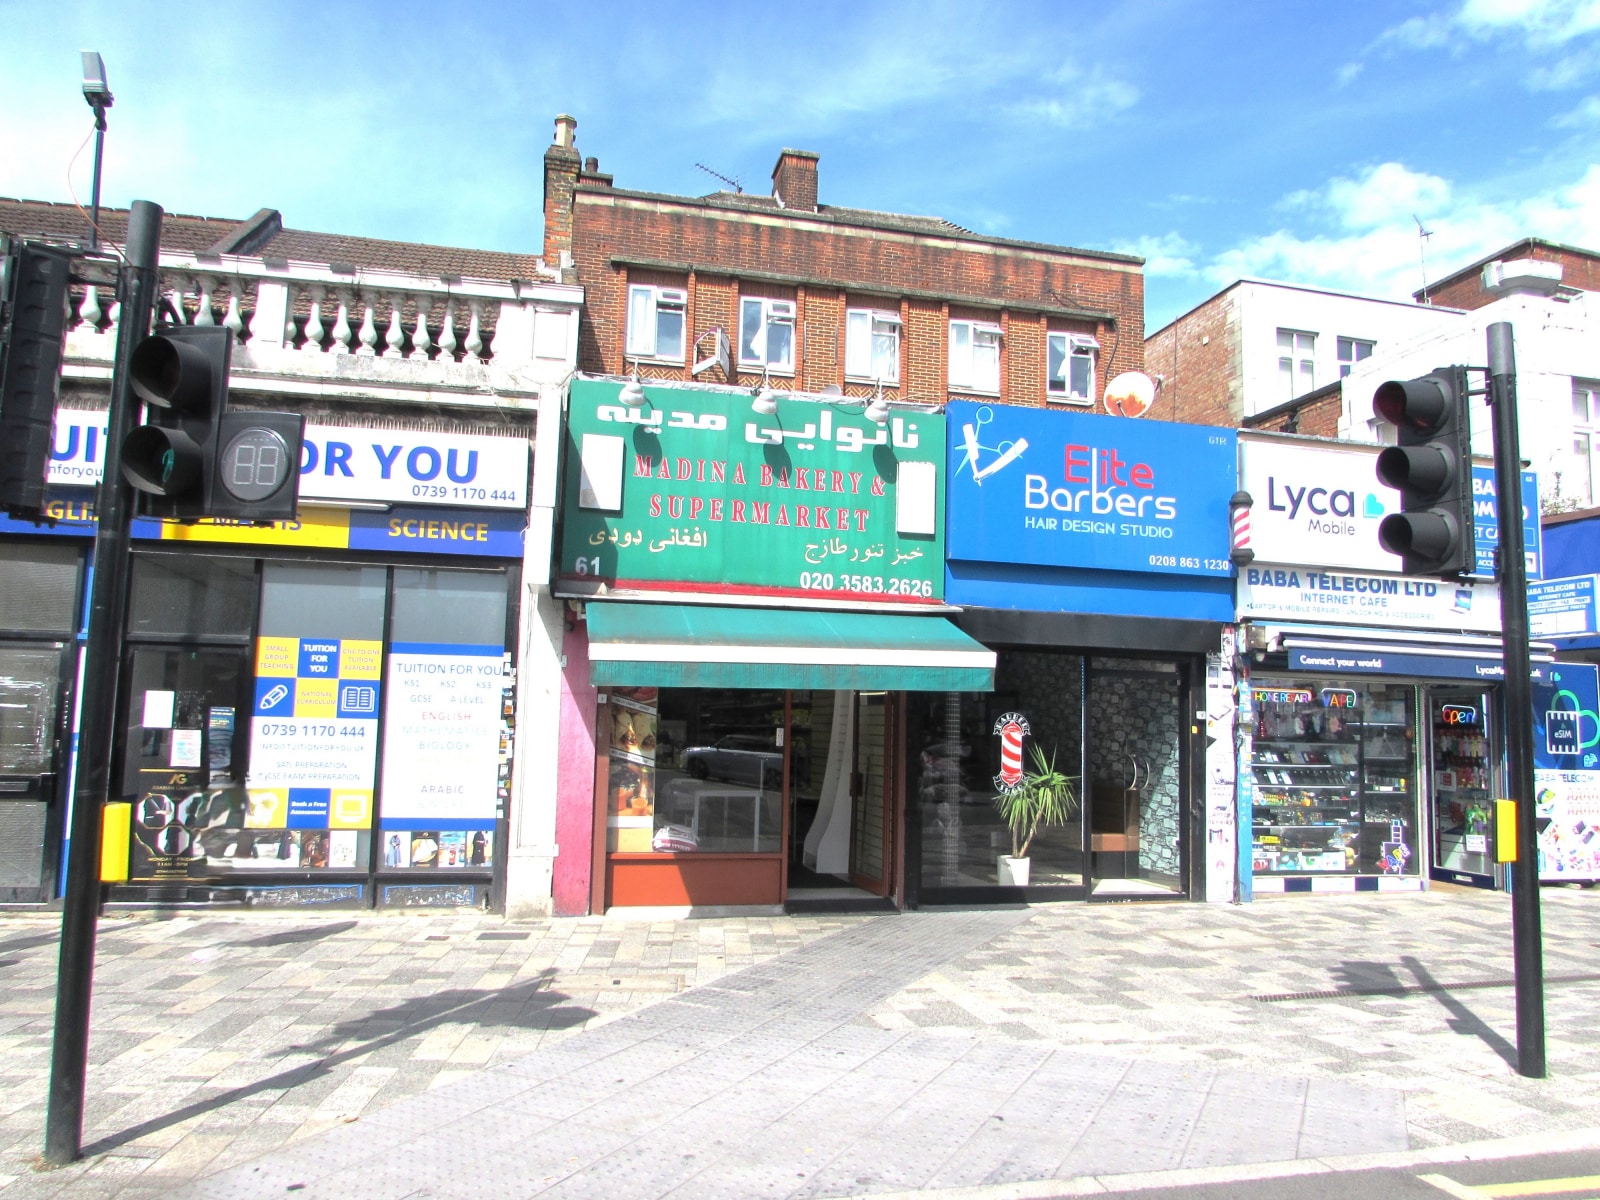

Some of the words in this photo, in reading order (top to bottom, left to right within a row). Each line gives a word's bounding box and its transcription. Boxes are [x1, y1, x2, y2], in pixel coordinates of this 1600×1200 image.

[372, 444, 479, 484] YOU
[1064, 444, 1154, 490] Elite
[633, 455, 747, 485] MADINA
[760, 464, 863, 495] BAKERY
[870, 475, 886, 496] &
[412, 484, 447, 498] 0739
[453, 487, 486, 500] 1170
[490, 489, 516, 502] 444
[1025, 456, 1177, 520] Barbers
[1268, 476, 1356, 520] Lyca
[649, 494, 870, 533] SUPERMARKET
[388, 518, 489, 542] SCIENCE
[1025, 516, 1058, 531] HAIR
[1062, 519, 1115, 535] DESIGN
[1120, 523, 1173, 539] STUDIO
[1307, 519, 1356, 536] Mobile
[849, 543, 884, 563] تنور
[890, 547, 924, 565] خبز
[575, 556, 600, 577] 61
[1149, 555, 1177, 567] 0208
[1179, 557, 1200, 569] 863
[1203, 559, 1229, 571] 1230
[799, 572, 834, 591] 020
[1247, 568, 1301, 588] BABA
[1306, 572, 1398, 595] TELECOM
[1404, 581, 1437, 597] LTD
[1300, 592, 1356, 606] INTERNET
[1360, 596, 1387, 608] CAFE
[303, 644, 337, 652] TUITION
[311, 655, 328, 663] FOR
[1300, 655, 1335, 666] Connect
[1336, 659, 1356, 668] your
[1357, 658, 1382, 668] world
[310, 665, 328, 673] YOU
[397, 663, 446, 674] TUITION
[450, 665, 473, 675] FOR
[477, 666, 502, 676] YOU
[404, 680, 419, 688] KS1
[410, 695, 432, 703] GCSE
[459, 696, 484, 704] LEVEL
[1280, 692, 1309, 703] REPAIR
[1321, 693, 1354, 708] VAPE
[422, 712, 471, 721] ENGLISH
[262, 724, 297, 736] 0739
[302, 725, 336, 737] 1170
[340, 727, 365, 737] 444
[1554, 730, 1573, 739] eSIM
[419, 741, 470, 750] BIOLOGY
[1558, 774, 1595, 783] TELECOM
[421, 785, 464, 794] ARABIC
